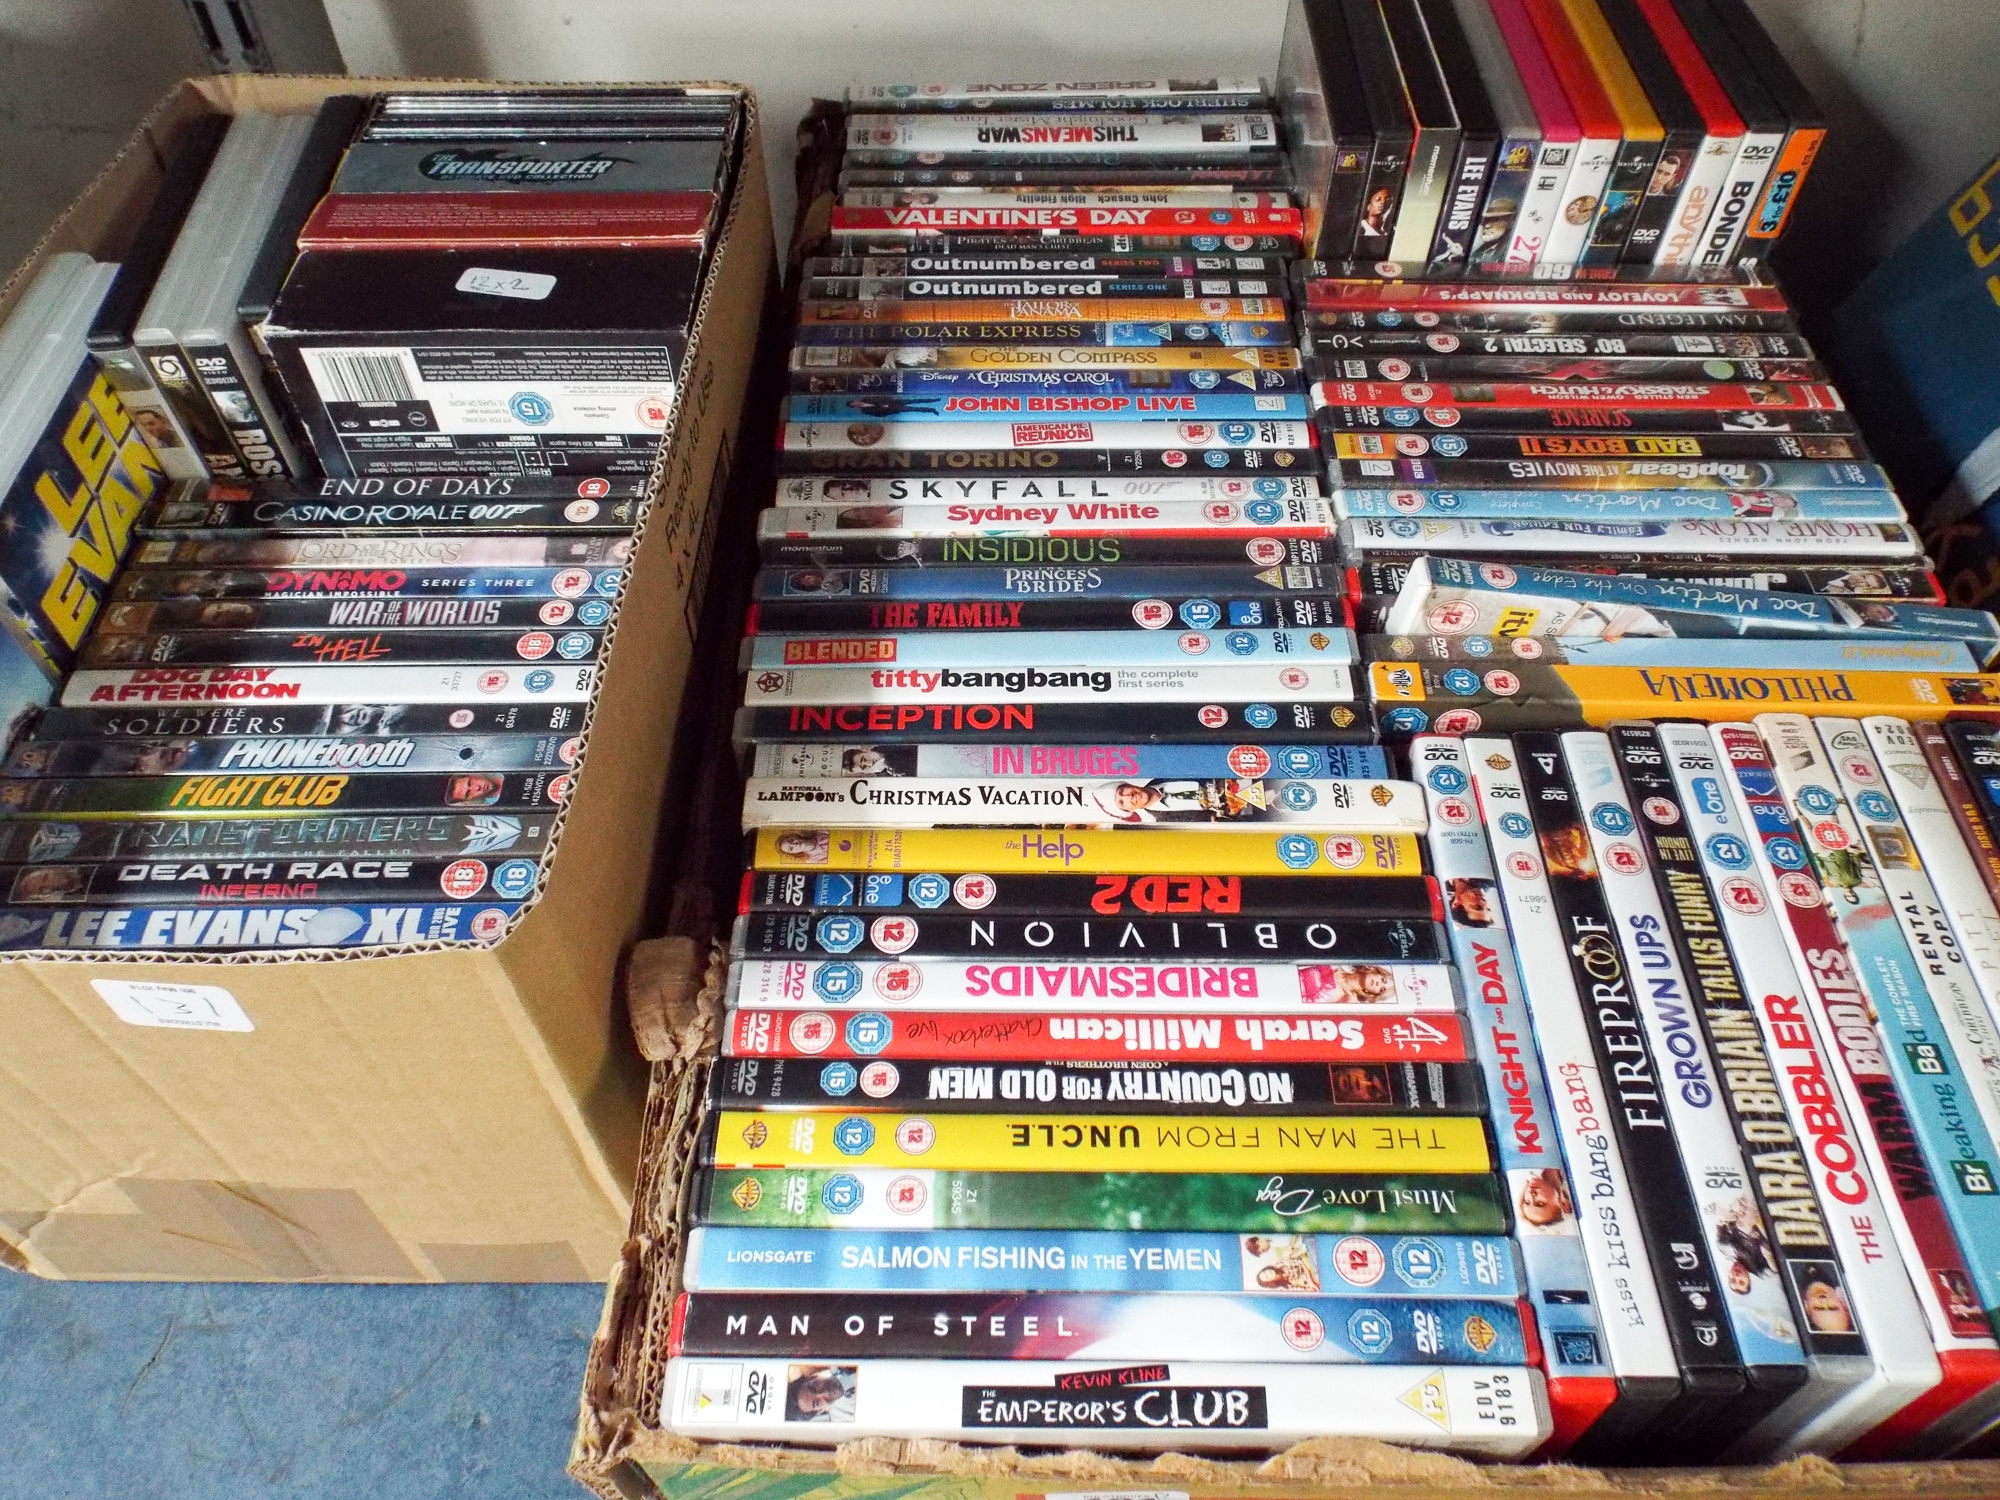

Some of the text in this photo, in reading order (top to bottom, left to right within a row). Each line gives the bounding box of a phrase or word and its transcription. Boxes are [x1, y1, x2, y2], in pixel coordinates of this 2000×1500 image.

[428, 160, 615, 175] TRANSPORTER
[1448, 157, 1487, 231] LEE EVANS
[885, 208, 1152, 227] VALENTINE'S DAY
[911, 257, 1096, 271] Outnumbered
[909, 279, 1103, 296] Outnumbered
[1595, 290, 1680, 303] LOVEJOY
[1618, 312, 1707, 328] LEGEND
[897, 325, 1082, 340] POLAR EXPRESS
[971, 349, 1158, 365] GOLDEN COMPASS
[1063, 371, 1115, 383] CAROL
[944, 396, 1197, 412] JOHN BISHOP LIVE
[1015, 430, 1091, 444] REUNION
[1558, 437, 1630, 456] BOYS
[1634, 437, 1700, 456] BAD
[927, 450, 1059, 467] TORINO
[1509, 461, 1578, 478] MOVIES
[319, 477, 514, 497] END OF DAYS
[888, 479, 1110, 499] SKYFALL
[366, 504, 467, 525] ROYALE
[946, 502, 1160, 525] Sydney White
[942, 536, 1120, 563] INSIDIOUS
[421, 578, 477, 588] SERIES
[485, 578, 535, 587] THREE
[1016, 578, 1098, 593] BRIDE
[265, 591, 401, 599] MAGICIAN IMPOSSIBLE
[328, 601, 382, 626] WAR
[403, 600, 502, 626] WORLDS
[926, 600, 1023, 627] FAMILY
[786, 640, 896, 662] BLENDED
[129, 666, 278, 684] DOG DAY
[1117, 669, 1137, 679] the
[1140, 669, 1199, 680] complete
[1117, 678, 1185, 689] first series
[89, 682, 302, 702] AFTERNOON
[1639, 669, 1856, 704] PHILOMENA
[103, 716, 287, 736] SOLDIERS
[790, 703, 1035, 731] INCEPTION
[993, 746, 1138, 777] IN BRUGES
[169, 774, 351, 807] FIGHT CLUB
[848, 779, 1085, 807] CHRISTMAS VACATION
[1022, 834, 1085, 866] Help
[117, 860, 413, 882] DEATH RACE
[199, 882, 318, 901] INFERNO
[1665, 869, 1719, 933] FUNNY
[42, 907, 428, 947] LEE EVANS XL
[969, 920, 1337, 949] OBLIVION
[1899, 889, 1947, 977] RENTAL
[1926, 904, 1962, 965] COPY
[1688, 937, 1742, 1003] TALKS
[966, 966, 1260, 998] BRIDESMAIDS
[1629, 913, 1713, 1109] GROWN UPS
[1807, 947, 1892, 1076] BODIES
[1047, 1015, 1223, 1050] Millican
[1235, 1018, 1366, 1050] Sarah
[1472, 940, 1544, 1155] KNIGHT DAY
[928, 1067, 1294, 1107] NO COUNTRY FOR OLD MEN
[1154, 1126, 1263, 1149] FROM
[1277, 1126, 1360, 1149] MAN
[1374, 1126, 1447, 1150] THE
[1763, 993, 1885, 1264] THE COBBLER
[1322, 1188, 1387, 1214] Love
[1393, 1188, 1459, 1214] Must
[1752, 1150, 1830, 1248] DARA
[726, 1245, 1222, 1271] LIONSGATE SALMON FISHING IN THE YEMEN
[725, 1315, 1079, 1337] MAN OF STEEL
[1059, 1366, 1168, 1390] KEVIN KLINE
[977, 1387, 1251, 1427] EMPEROR'S CLUB
